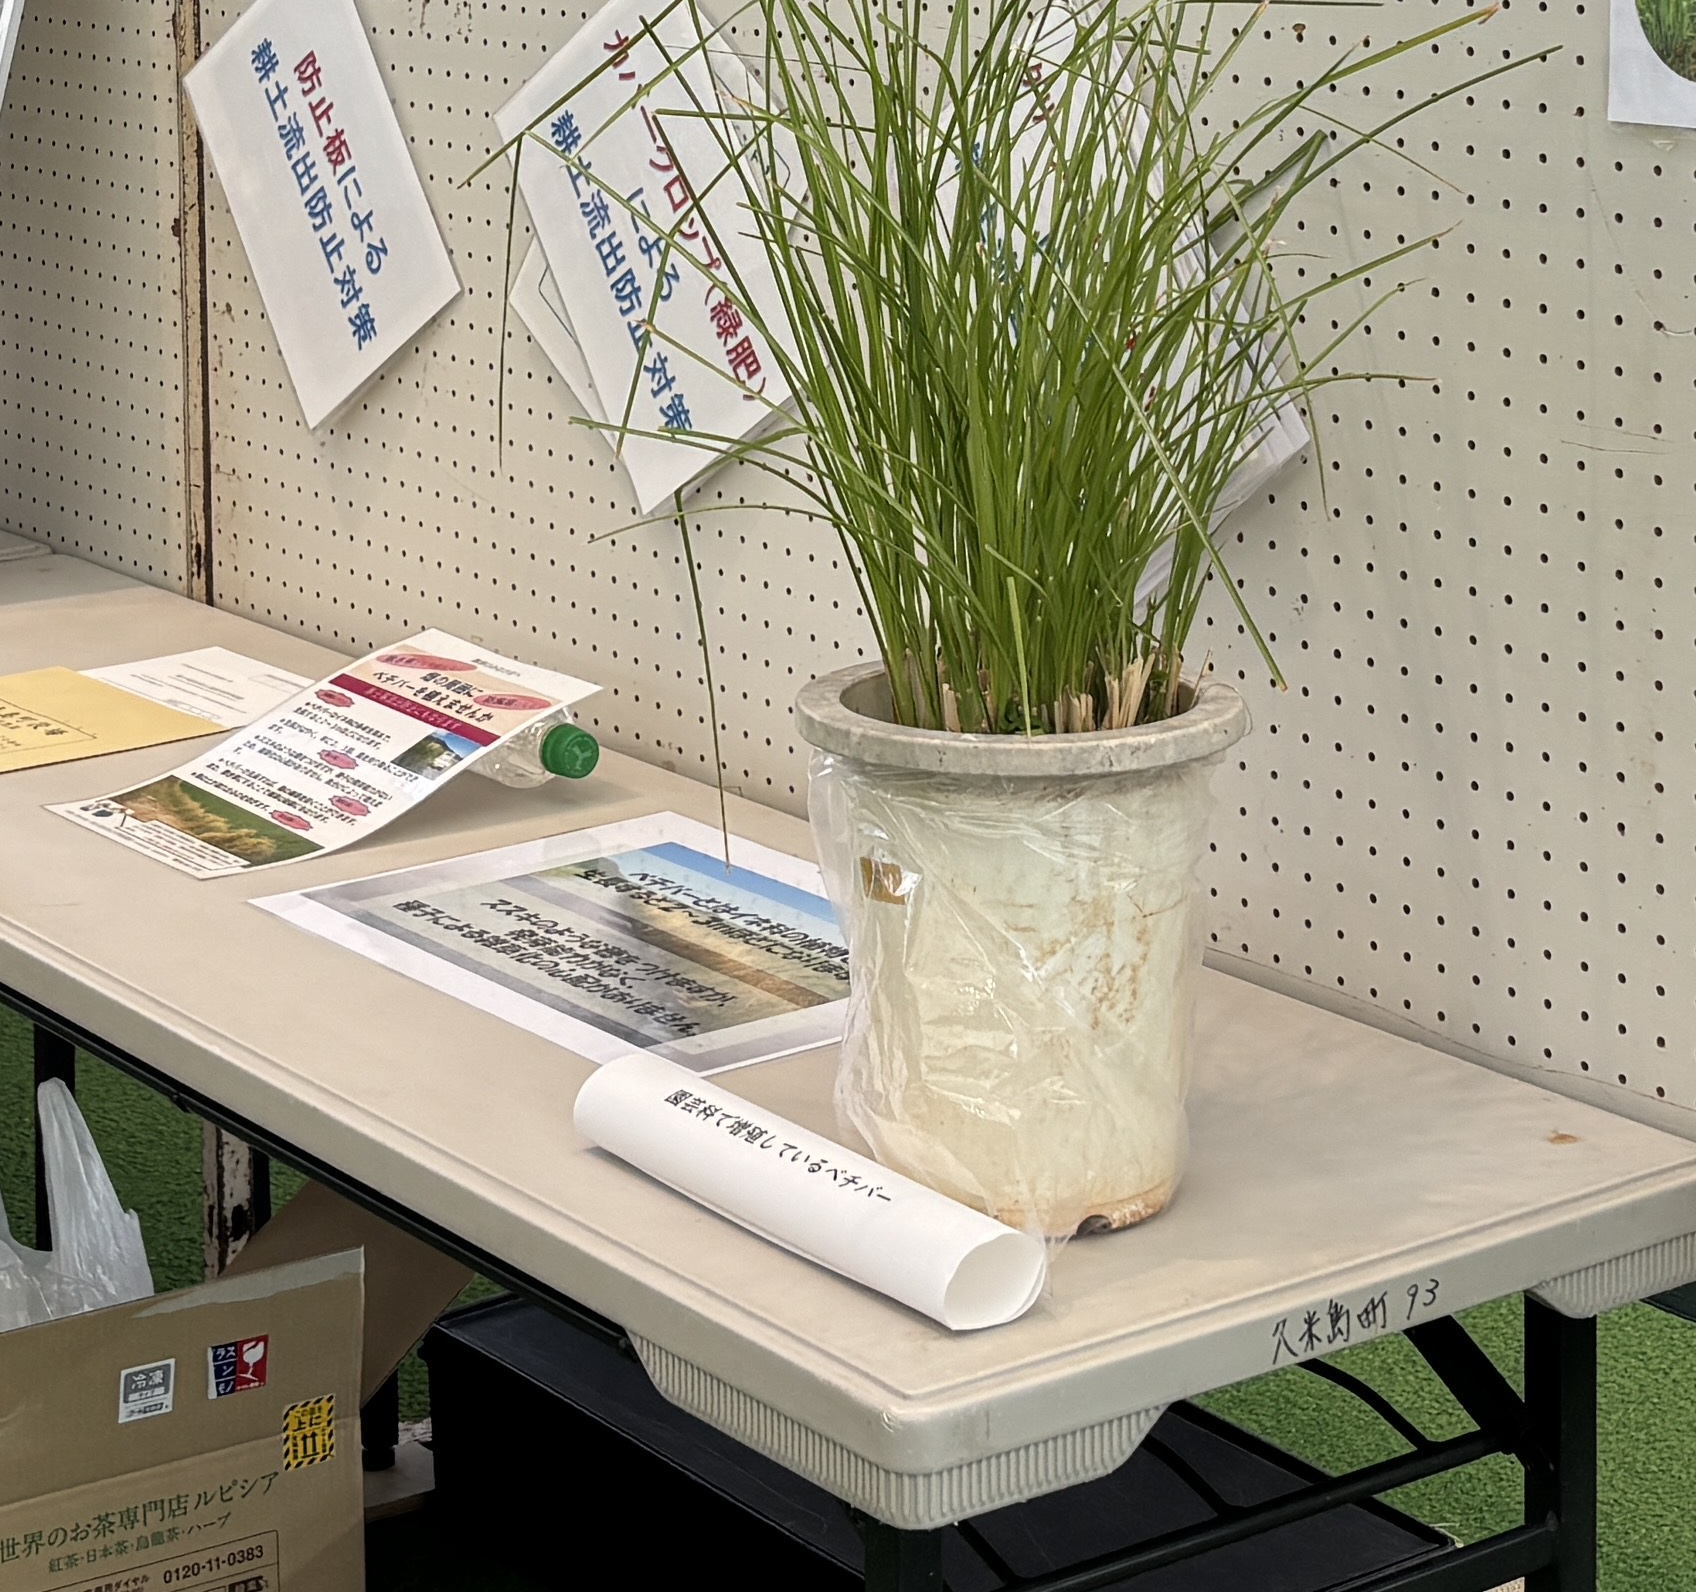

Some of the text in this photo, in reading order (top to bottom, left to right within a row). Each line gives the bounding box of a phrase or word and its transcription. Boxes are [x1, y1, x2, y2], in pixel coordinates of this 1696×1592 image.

[293, 50, 389, 275] 防止板による
[626, 187, 680, 302] による
[1272, 1279, 1440, 1365] 久米島町 93
[131, 1369, 164, 1389] 冷凍
